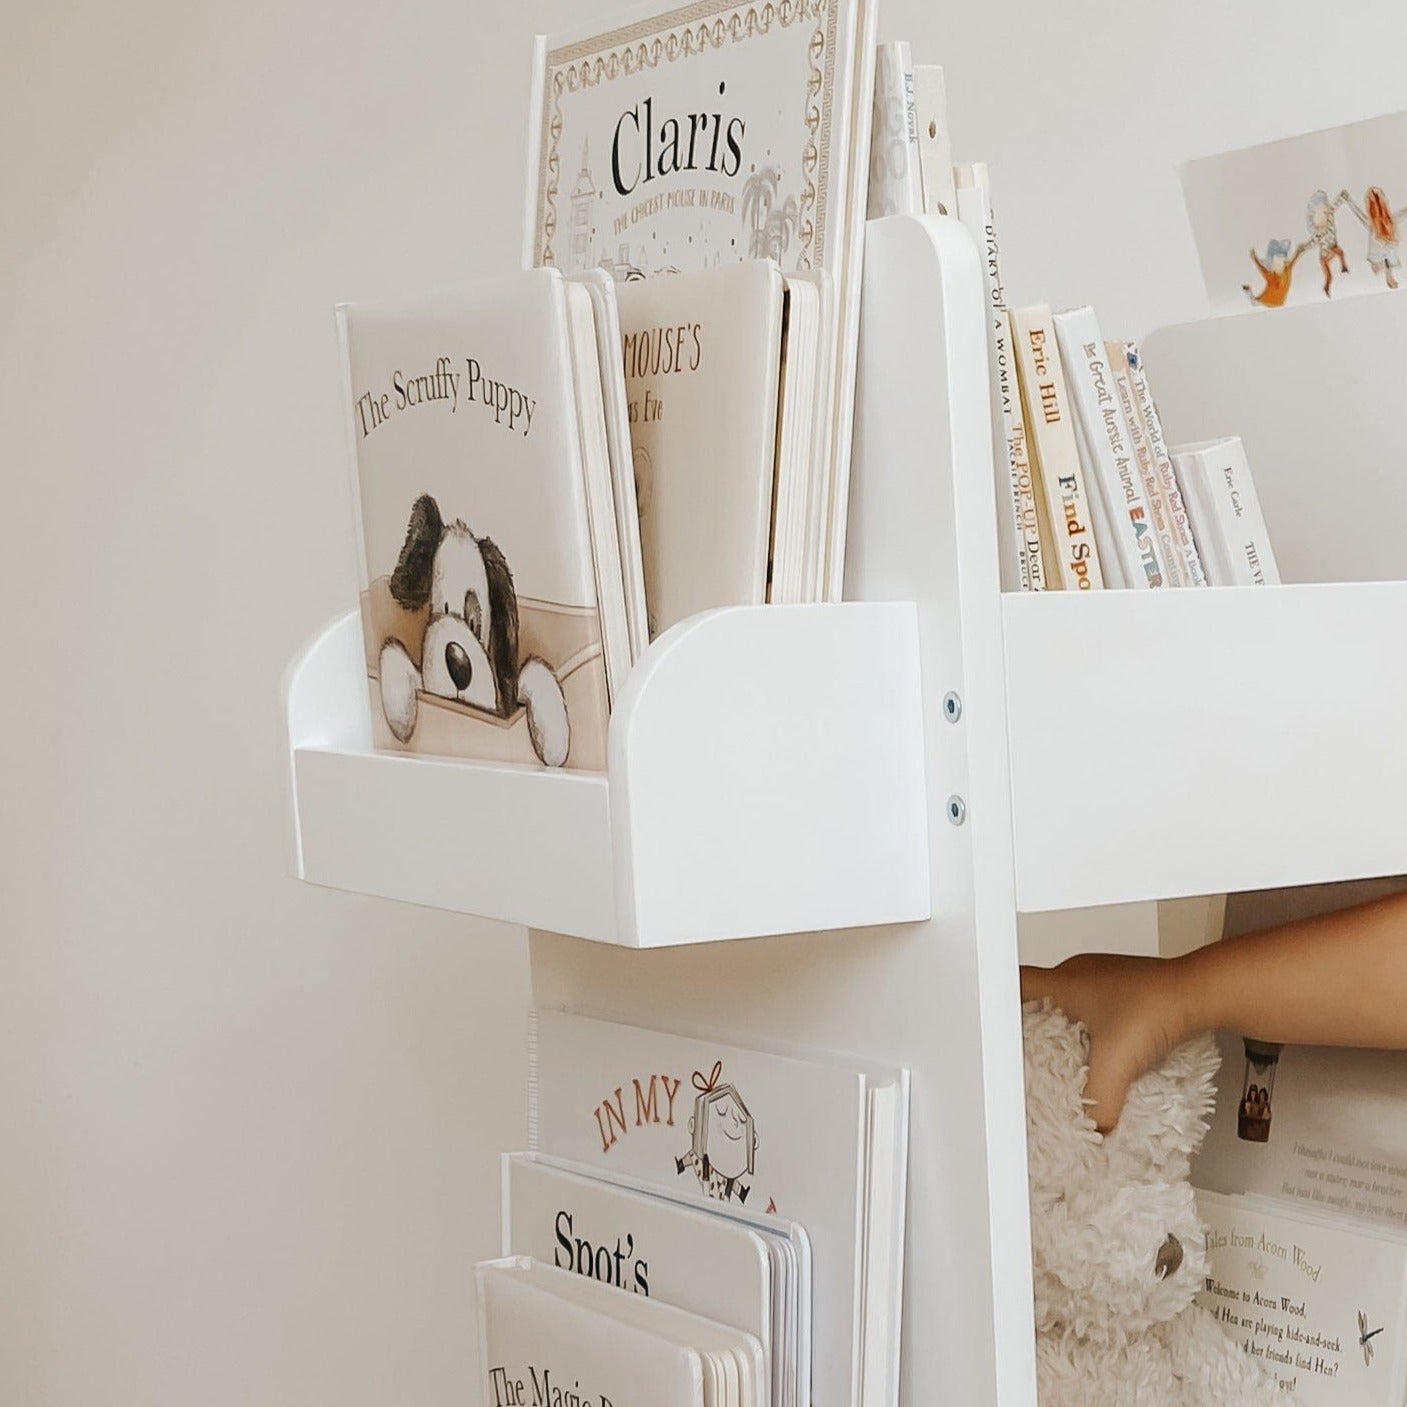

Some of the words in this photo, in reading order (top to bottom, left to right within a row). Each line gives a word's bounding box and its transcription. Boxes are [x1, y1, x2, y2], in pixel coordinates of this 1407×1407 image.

[611, 81, 746, 197] Claris
[907, 101, 919, 144] Novak
[985, 225, 998, 277] DIARY
[995, 319, 1002, 329] A
[623, 323, 701, 379] MOUSE'S
[355, 391, 390, 439] The
[393, 356, 460, 413] Scruffy
[466, 358, 537, 437] Puppy
[996, 338, 1011, 414] WOMBAT
[1029, 328, 1049, 376] Eric
[1039, 383, 1060, 424] Hill
[1117, 376, 1133, 414] Learn
[644, 390, 663, 422] Eve
[1012, 422, 1024, 457] The
[1128, 416, 1143, 446] with
[1089, 361, 1112, 405] Great
[1102, 408, 1124, 454] Aussie
[1115, 457, 1140, 504] Animal
[1128, 505, 1163, 589] EASTER
[1135, 378, 1146, 404] The
[1143, 405, 1161, 444] World
[1154, 446, 1165, 458] of
[1160, 461, 1175, 490] Ruby
[1168, 490, 1182, 513] Red
[1175, 514, 1189, 546] Shoes
[1016, 462, 1037, 535] POP-UP
[1058, 473, 1086, 536] Find
[1146, 476, 1159, 497] Red
[1224, 466, 1233, 489] Eric
[1230, 490, 1243, 518] Carle
[1151, 499, 1165, 531] Shoes
[1027, 540, 1041, 581] Dear
[1245, 541, 1259, 569] THE
[594, 1088, 627, 1152] IN
[632, 1074, 681, 1127] MY
[554, 1211, 649, 1297] Spot's
[1205, 1231, 1227, 1250] Tales
[1231, 1230, 1254, 1248] from
[1257, 1232, 1287, 1260] Acorn
[1293, 1245, 1321, 1282] Wood
[1205, 1277, 1239, 1299] Welcome
[1242, 1291, 1250, 1302] to
[1253, 1291, 1277, 1310] Acorn
[1222, 1307, 1238, 1325] Hen
[1241, 1320, 1252, 1329] are
[1255, 1318, 1283, 1342] playing
[1251, 1339, 1263, 1356] her
[1265, 1344, 1292, 1365] friends
[1295, 1352, 1311, 1370] find
[1314, 1357, 1339, 1377] Hen?
[489, 1367, 525, 1407] The
